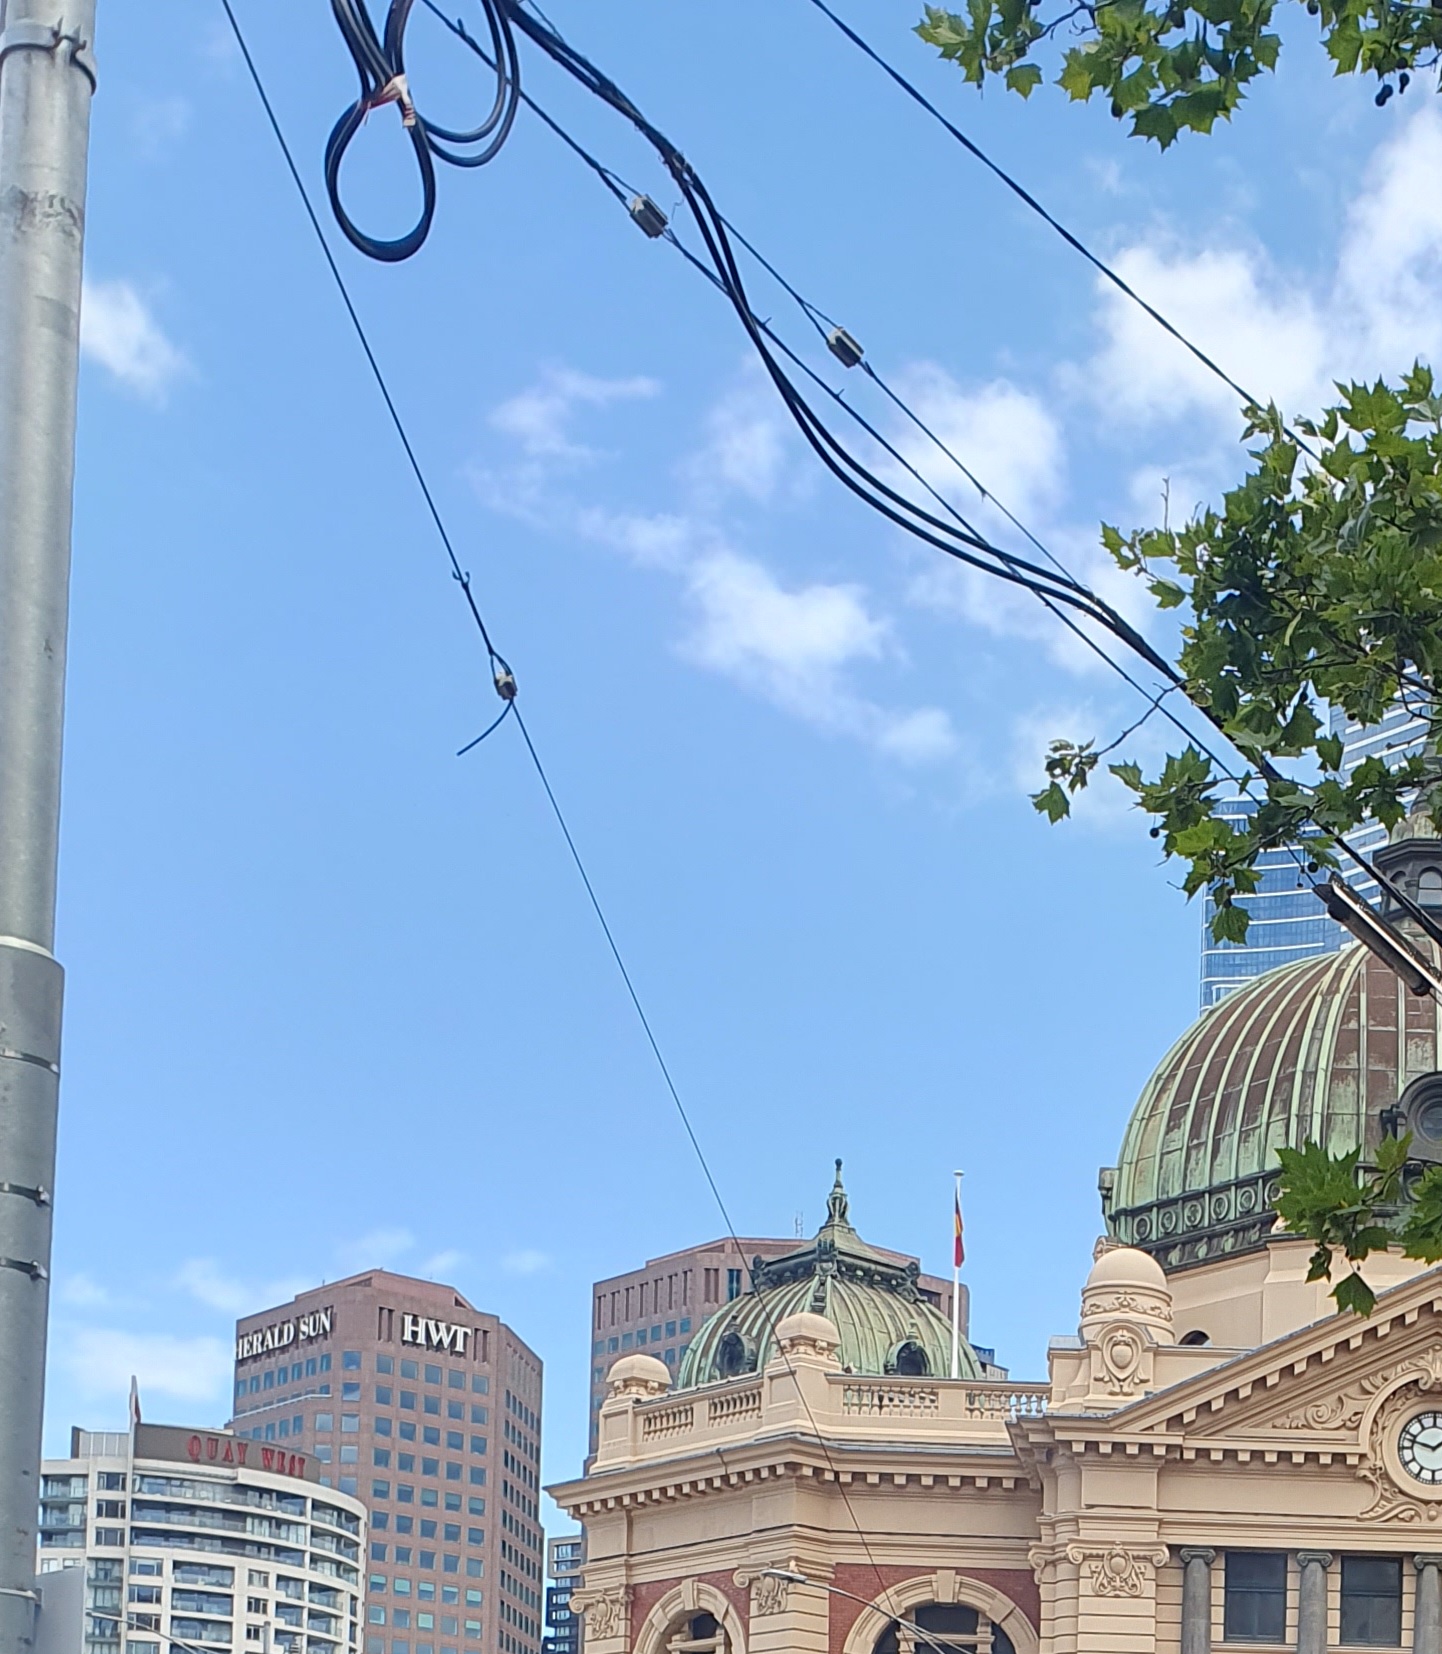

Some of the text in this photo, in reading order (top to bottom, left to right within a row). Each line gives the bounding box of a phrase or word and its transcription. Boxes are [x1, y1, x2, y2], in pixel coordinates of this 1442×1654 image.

[299, 1304, 333, 1341] SUN
[403, 1313, 472, 1353] HWT
[187, 1434, 306, 1479] QUAY WEST
